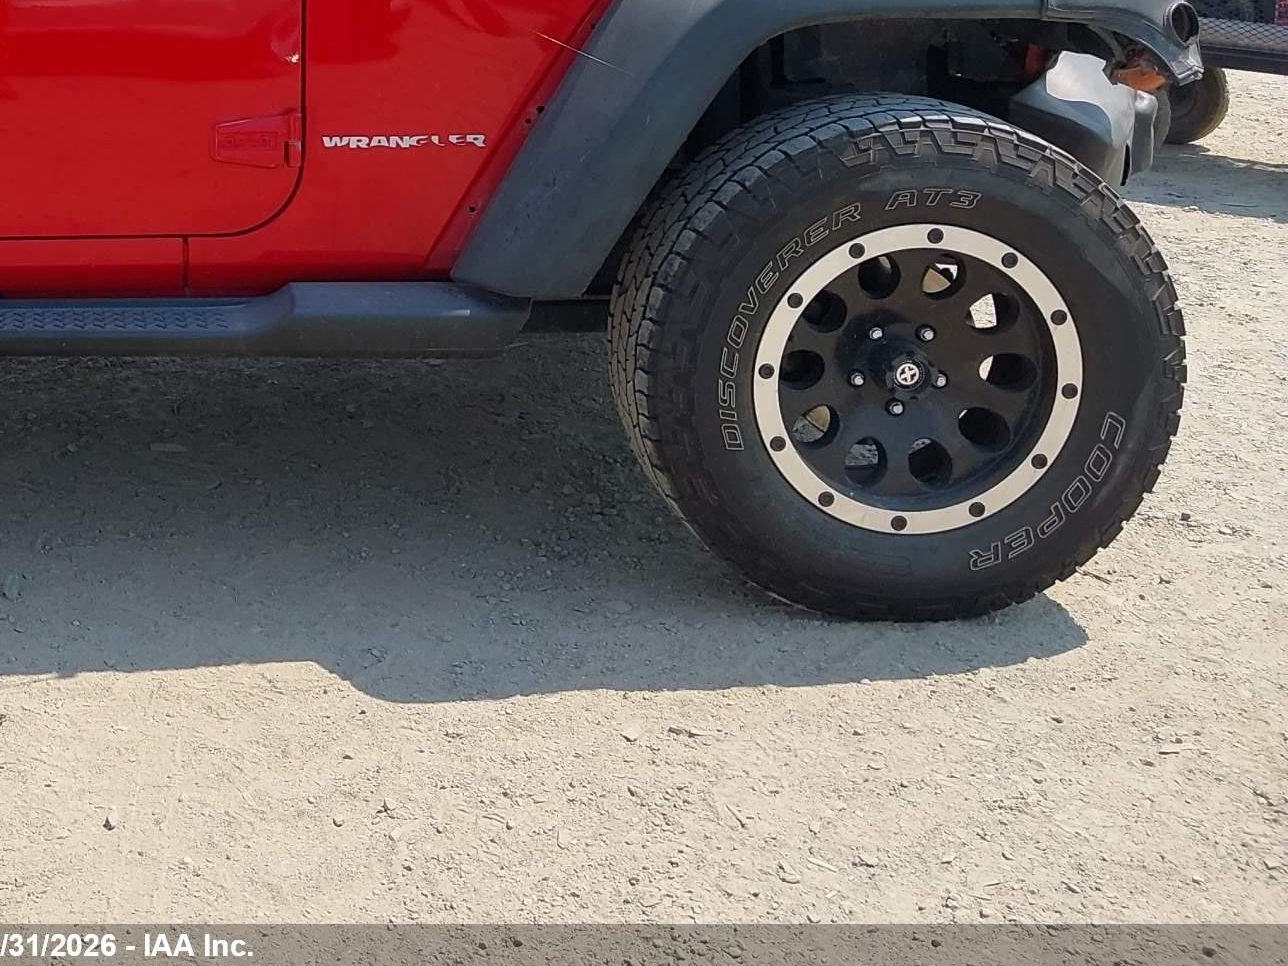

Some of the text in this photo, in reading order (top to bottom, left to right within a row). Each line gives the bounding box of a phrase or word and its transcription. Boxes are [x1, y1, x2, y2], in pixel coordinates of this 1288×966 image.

[321, 134, 487, 149] WRANGLER
[717, 188, 982, 450] DISCOVERER AT3
[968, 411, 1127, 571] COOPER
